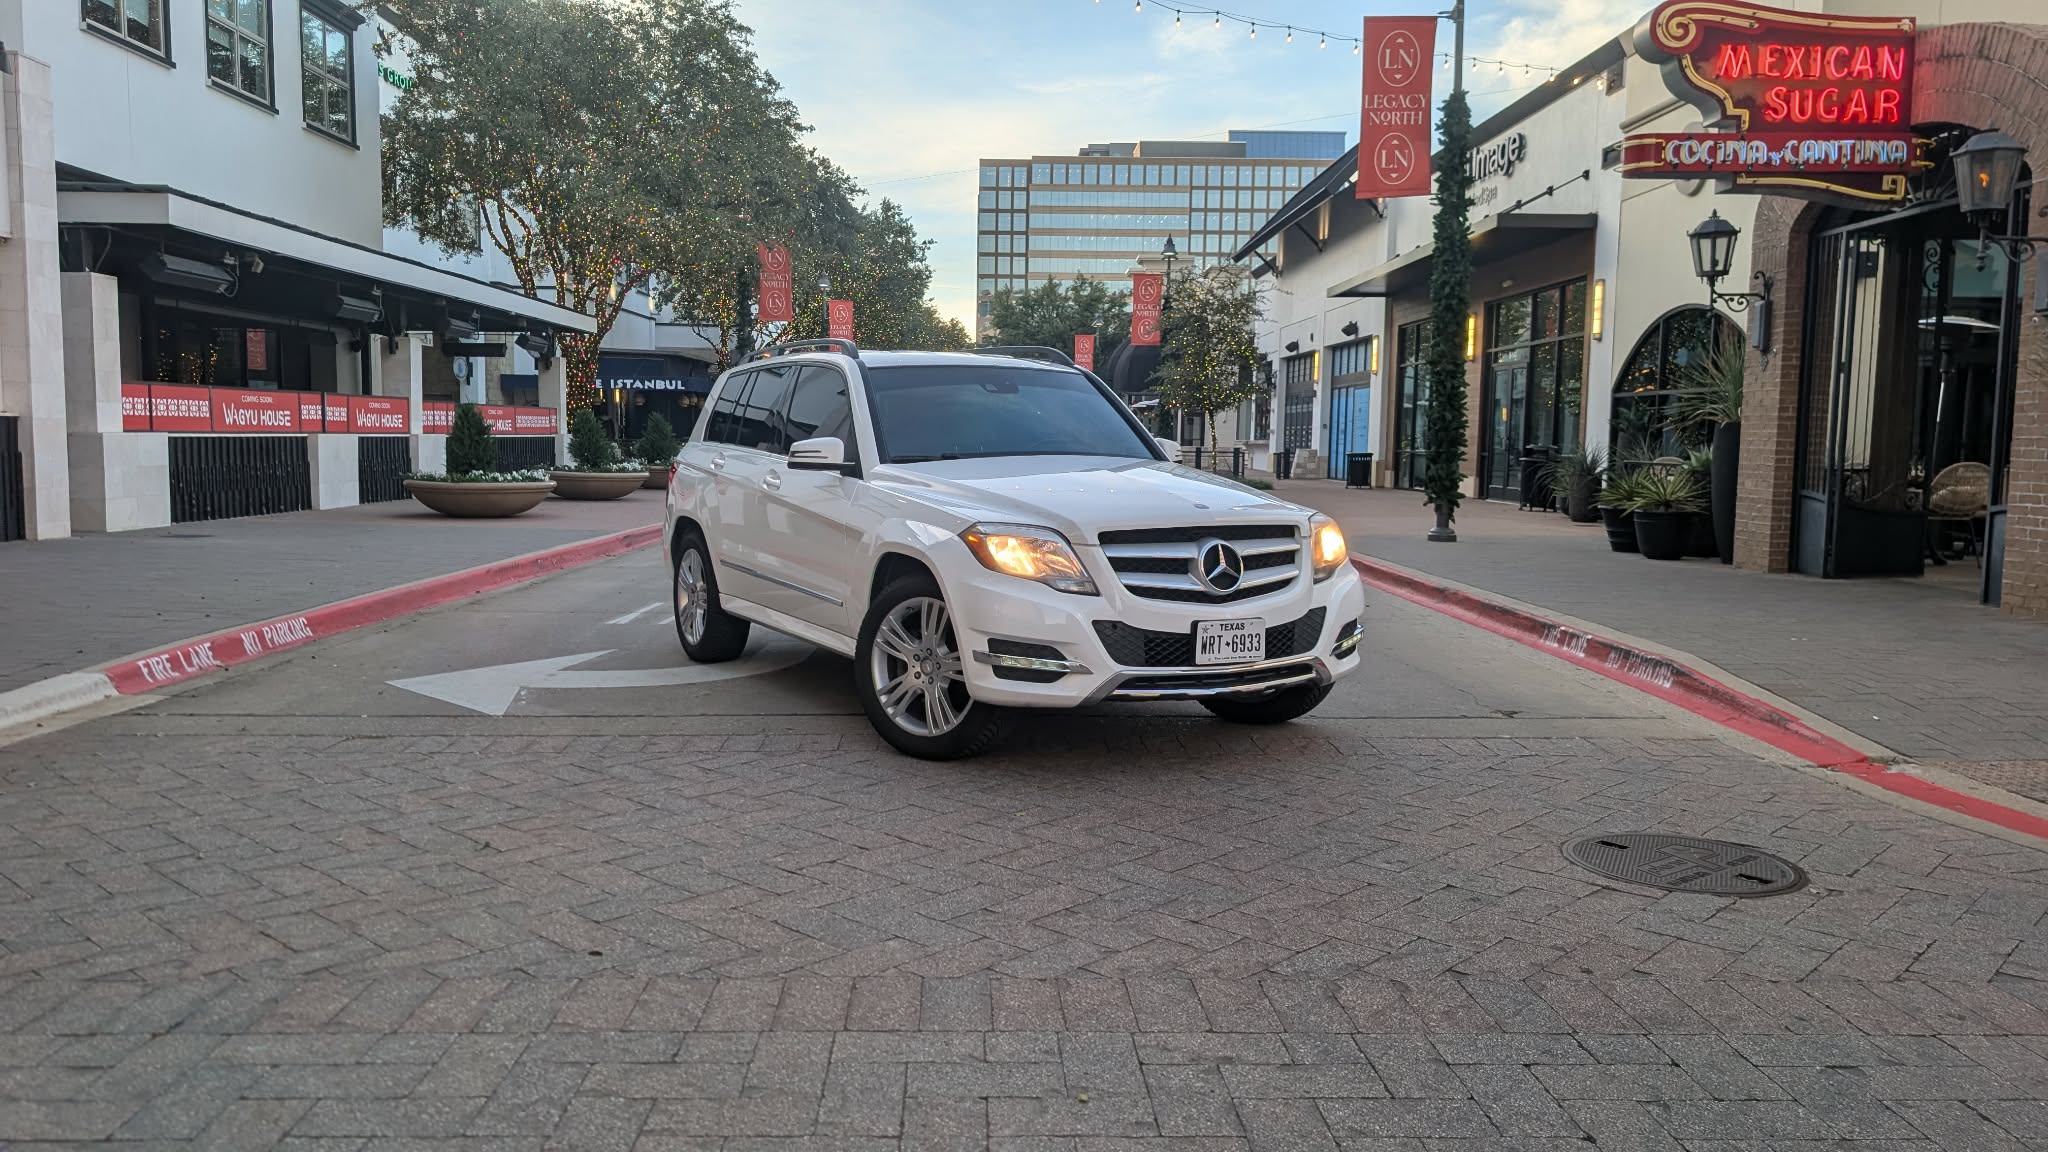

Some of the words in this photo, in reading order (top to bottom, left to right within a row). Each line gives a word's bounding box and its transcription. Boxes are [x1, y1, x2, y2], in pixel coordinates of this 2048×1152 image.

[1384, 49, 1414, 69] LN
[1716, 43, 1905, 81] MEXICAN
[1364, 94, 1428, 109] LEGACY
[1764, 86, 1900, 123] SUGAR
[1369, 111, 1423, 126] NORTH
[1381, 150, 1409, 169] LN
[1472, 132, 1523, 180] Image
[1665, 139, 1767, 165] COCINA
[1783, 139, 1907, 165] CANTINA
[763, 281, 788, 289] NORTH
[610, 379, 685, 390] ISTANBUL
[241, 395, 259, 403] COMING
[260, 396, 273, 404] SOON
[222, 402, 258, 426] WAGYU
[260, 409, 292, 427] HOUSE
[355, 408, 380, 427] WAGYU
[381, 413, 403, 428] HOUSE
[1220, 622, 1245, 632] TEXAS
[137, 653, 180, 684] FIRE
[177, 642, 221, 673] LANE
[240, 630, 263, 656] NO
[262, 616, 313, 649] PARKING
[1201, 635, 1223, 655] WRT
[1231, 633, 1261, 654] 6933
